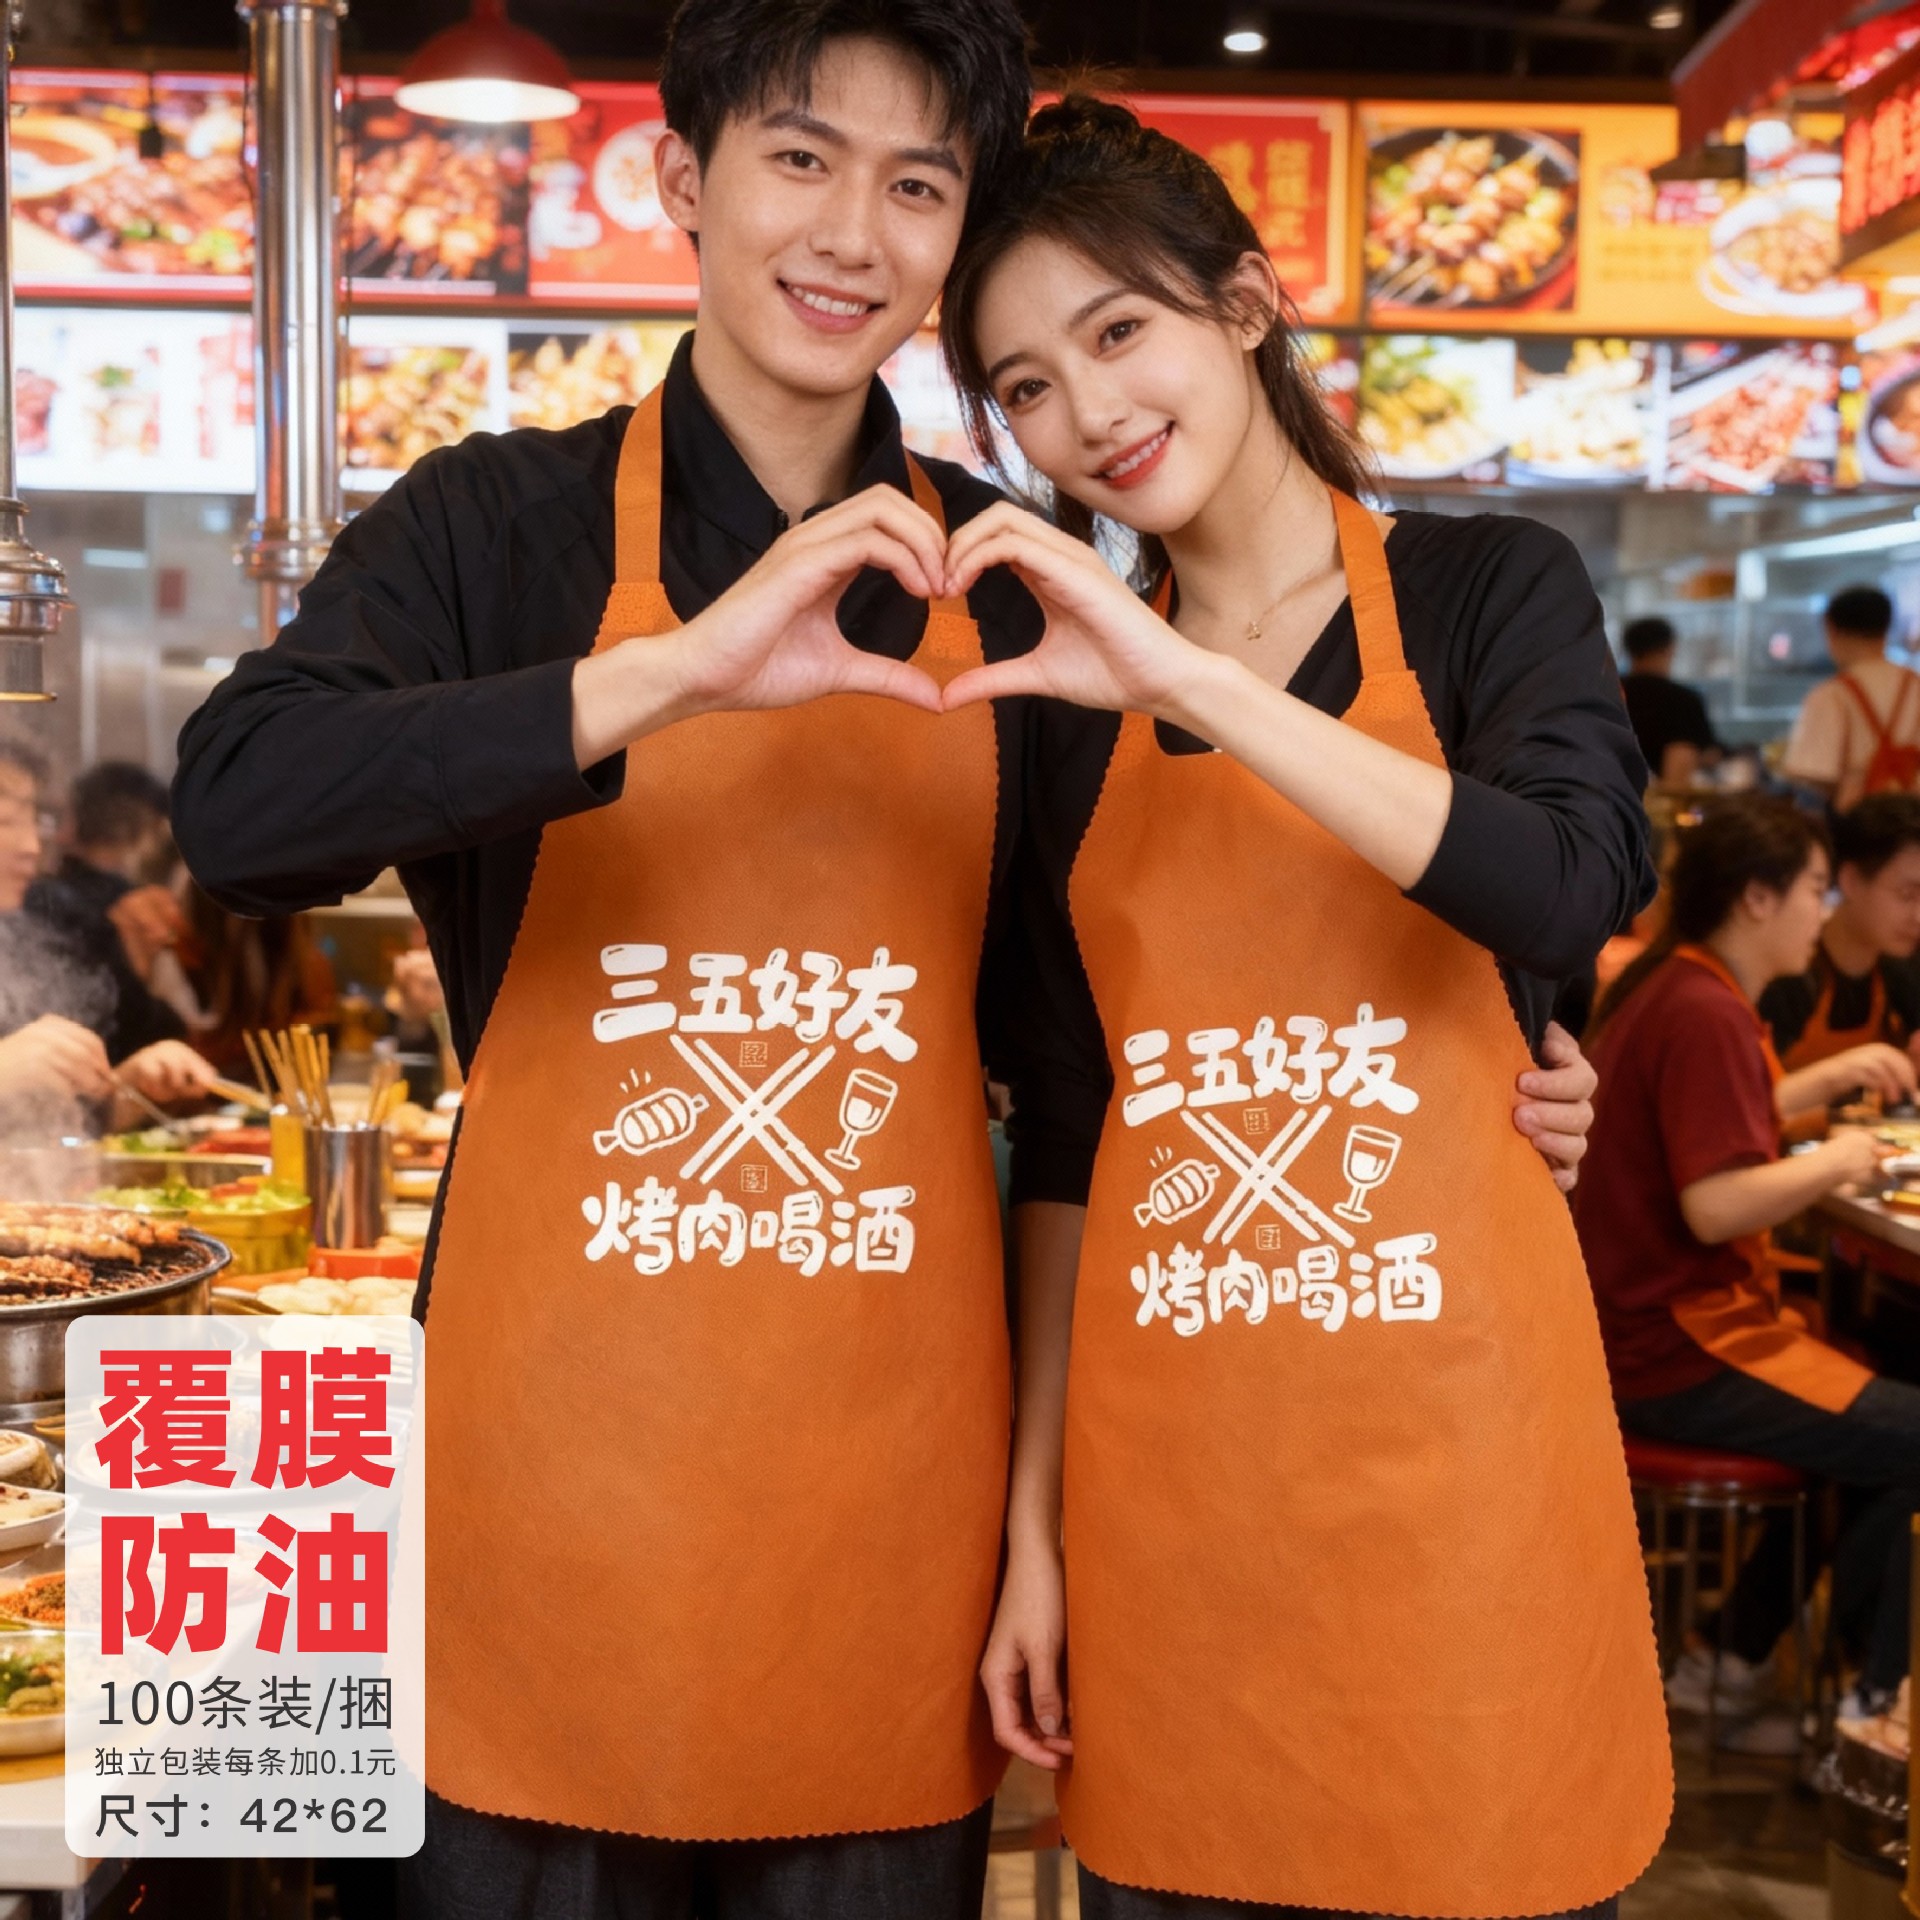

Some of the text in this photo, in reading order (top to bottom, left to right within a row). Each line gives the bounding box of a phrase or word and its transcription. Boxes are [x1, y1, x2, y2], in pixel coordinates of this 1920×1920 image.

[593, 944, 918, 1062] 三五好友
[1123, 1003, 1420, 1127] 三五好友
[581, 1176, 916, 1277] 烤肉喝酒
[1130, 1232, 1443, 1337] 烤肉喝酒
